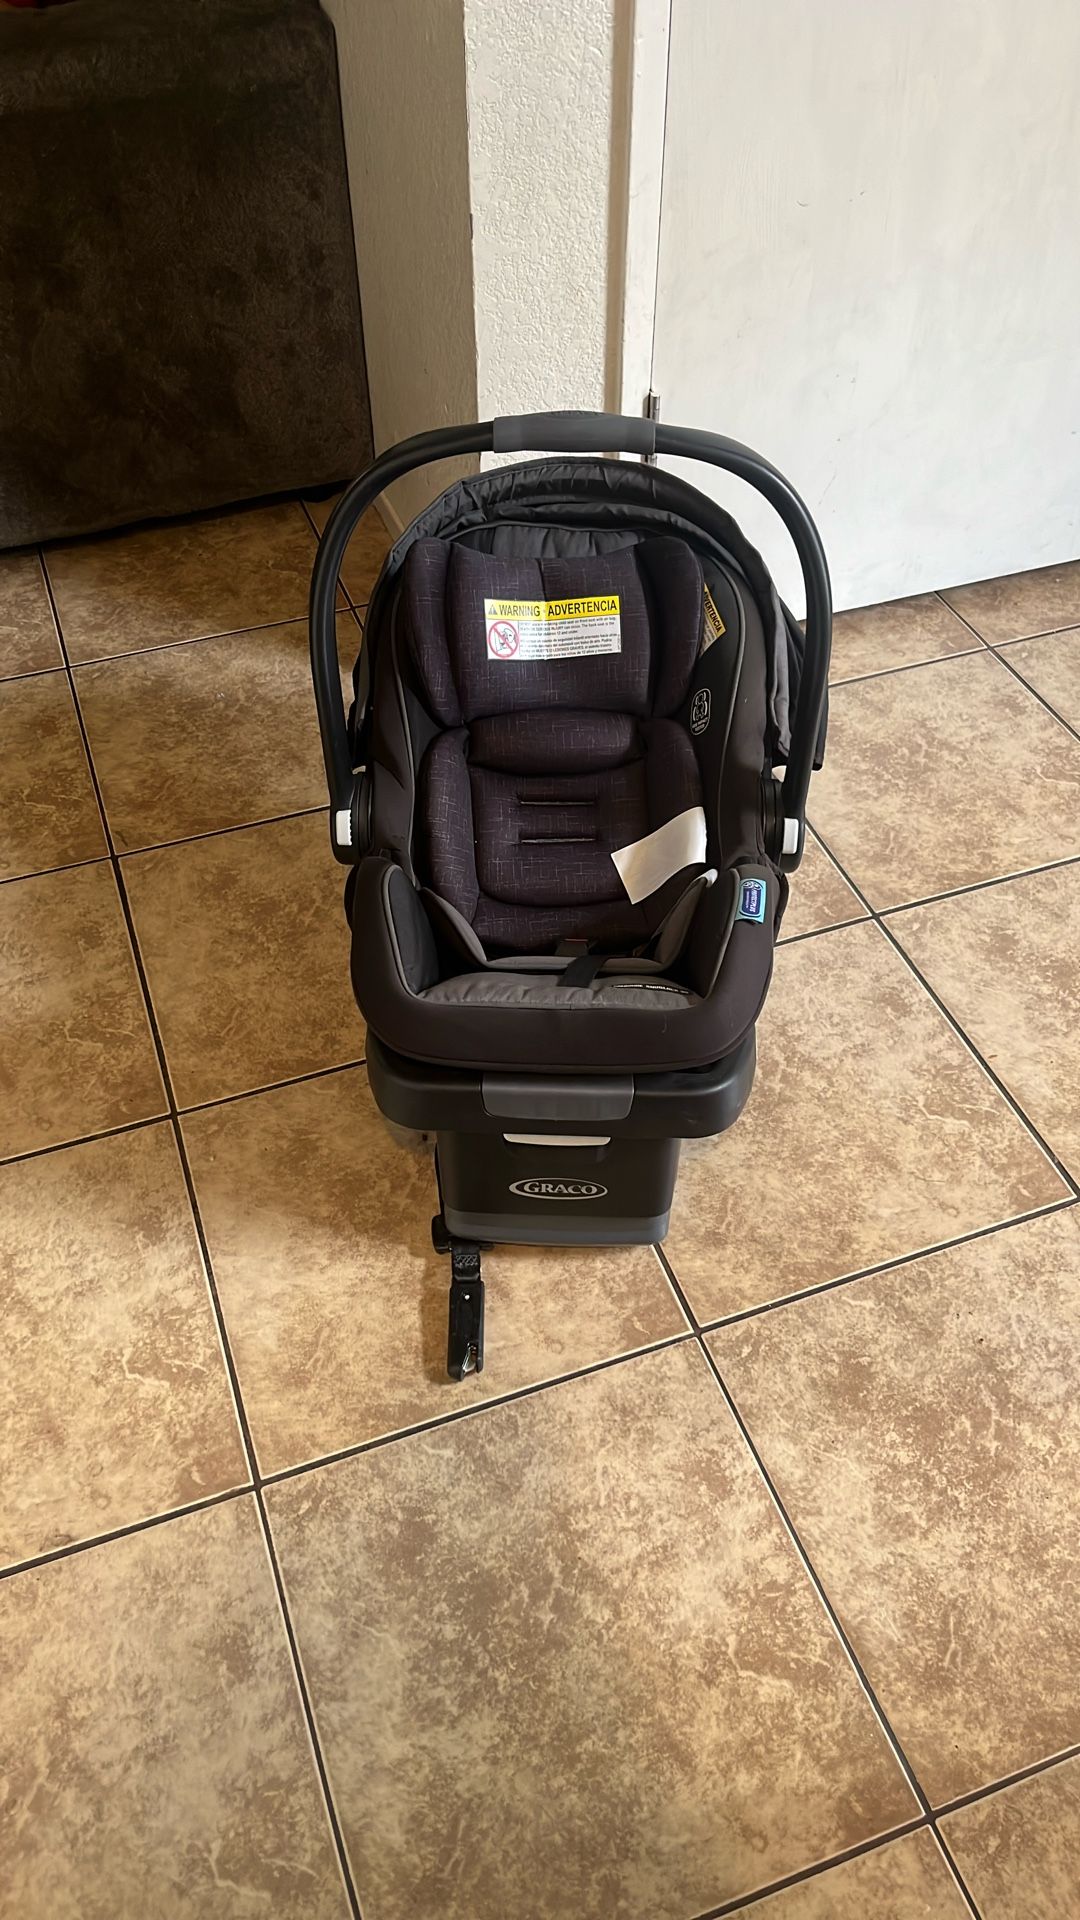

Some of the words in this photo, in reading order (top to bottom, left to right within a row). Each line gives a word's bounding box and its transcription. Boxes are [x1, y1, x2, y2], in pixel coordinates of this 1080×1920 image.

[499, 604, 541, 617] WARNING
[548, 600, 617, 617] ADVERTENCIA
[523, 1182, 598, 1194] GRACO
